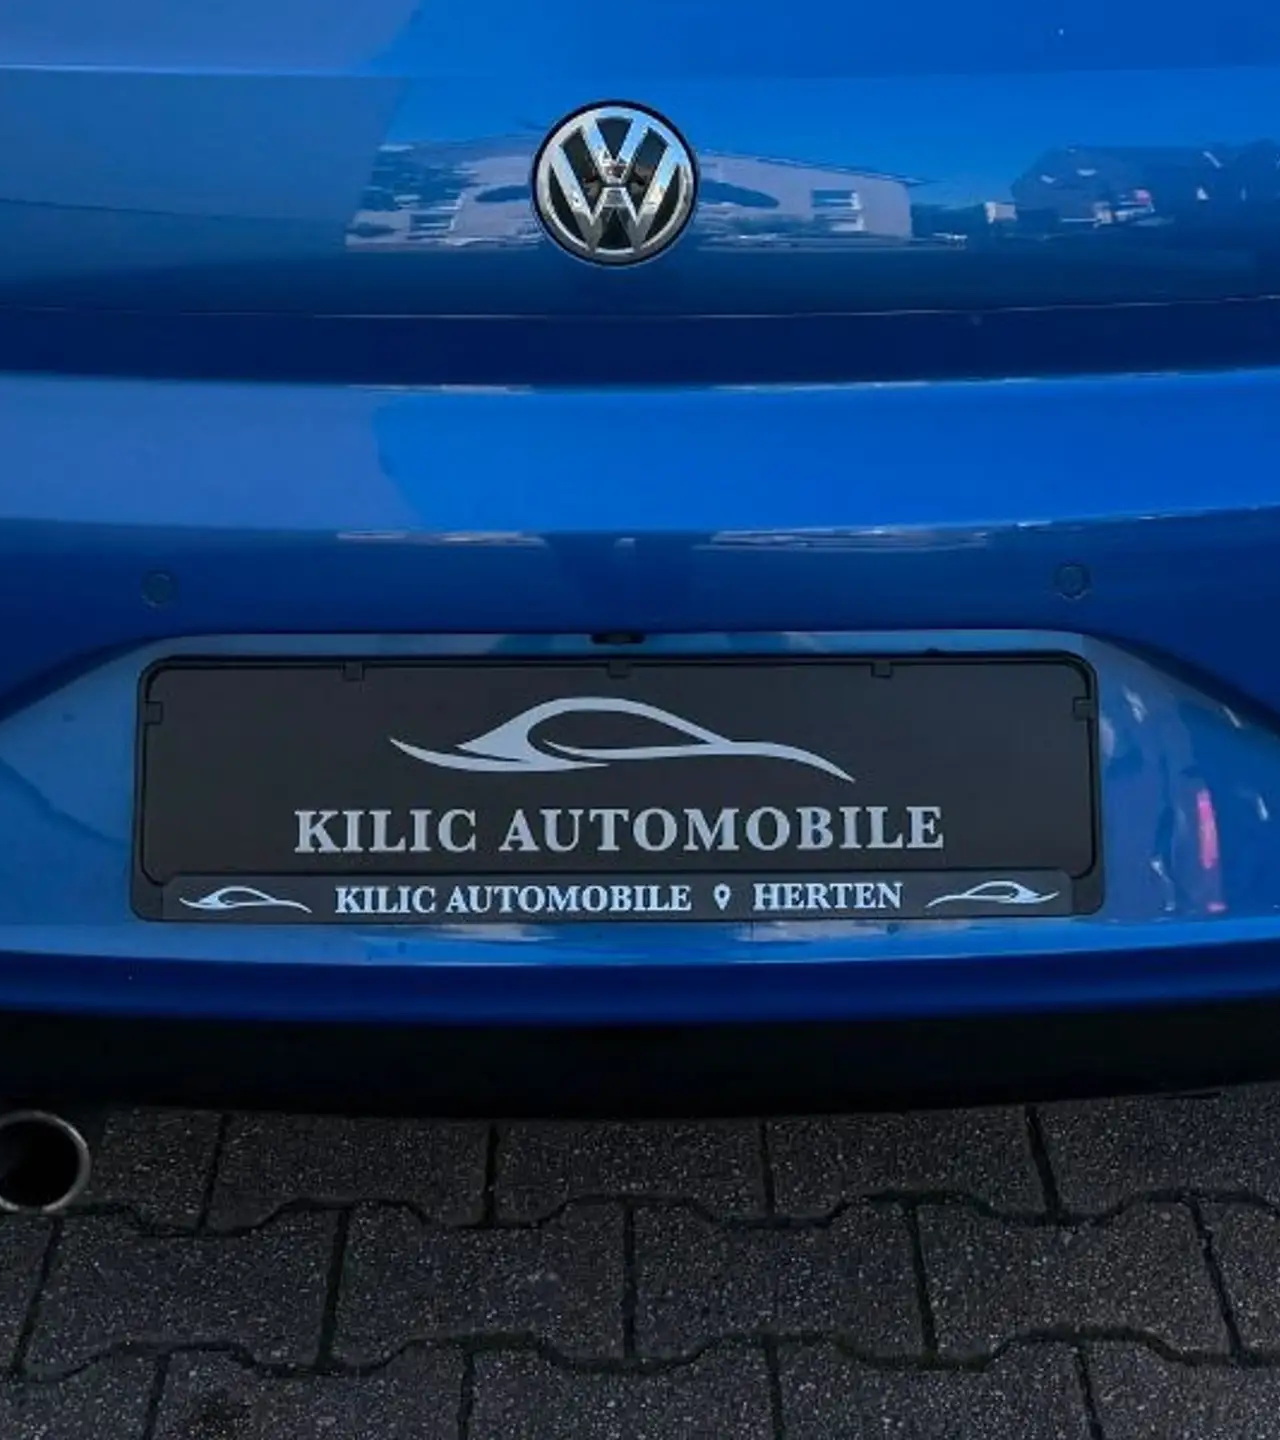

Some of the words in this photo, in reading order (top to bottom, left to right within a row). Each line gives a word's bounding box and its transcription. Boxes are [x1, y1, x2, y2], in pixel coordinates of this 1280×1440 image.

[293, 809, 477, 854] KILIC
[499, 805, 945, 853] AUTOMOBILE
[334, 885, 436, 914] KILIC
[445, 884, 692, 914] AUTOMOBILE
[752, 881, 903, 910] HERTEN
